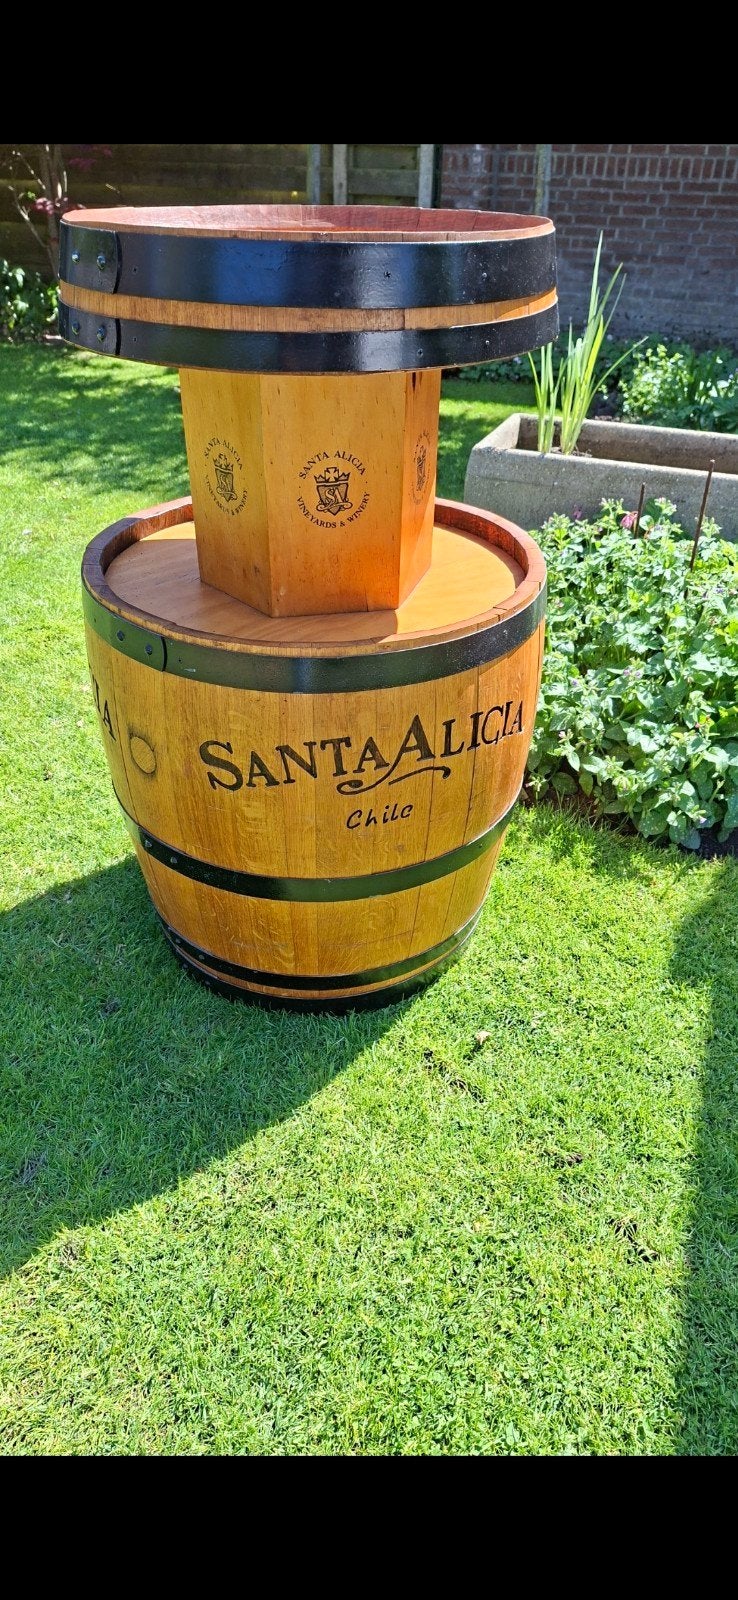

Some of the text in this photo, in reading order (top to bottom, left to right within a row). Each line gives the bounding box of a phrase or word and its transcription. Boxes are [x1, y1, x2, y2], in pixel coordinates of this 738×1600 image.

[299, 450, 366, 479] SANTA ALICIA
[297, 496, 337, 529] VINEYARDS
[347, 491, 370, 523] WINERY
[199, 736, 390, 791] SANTA
